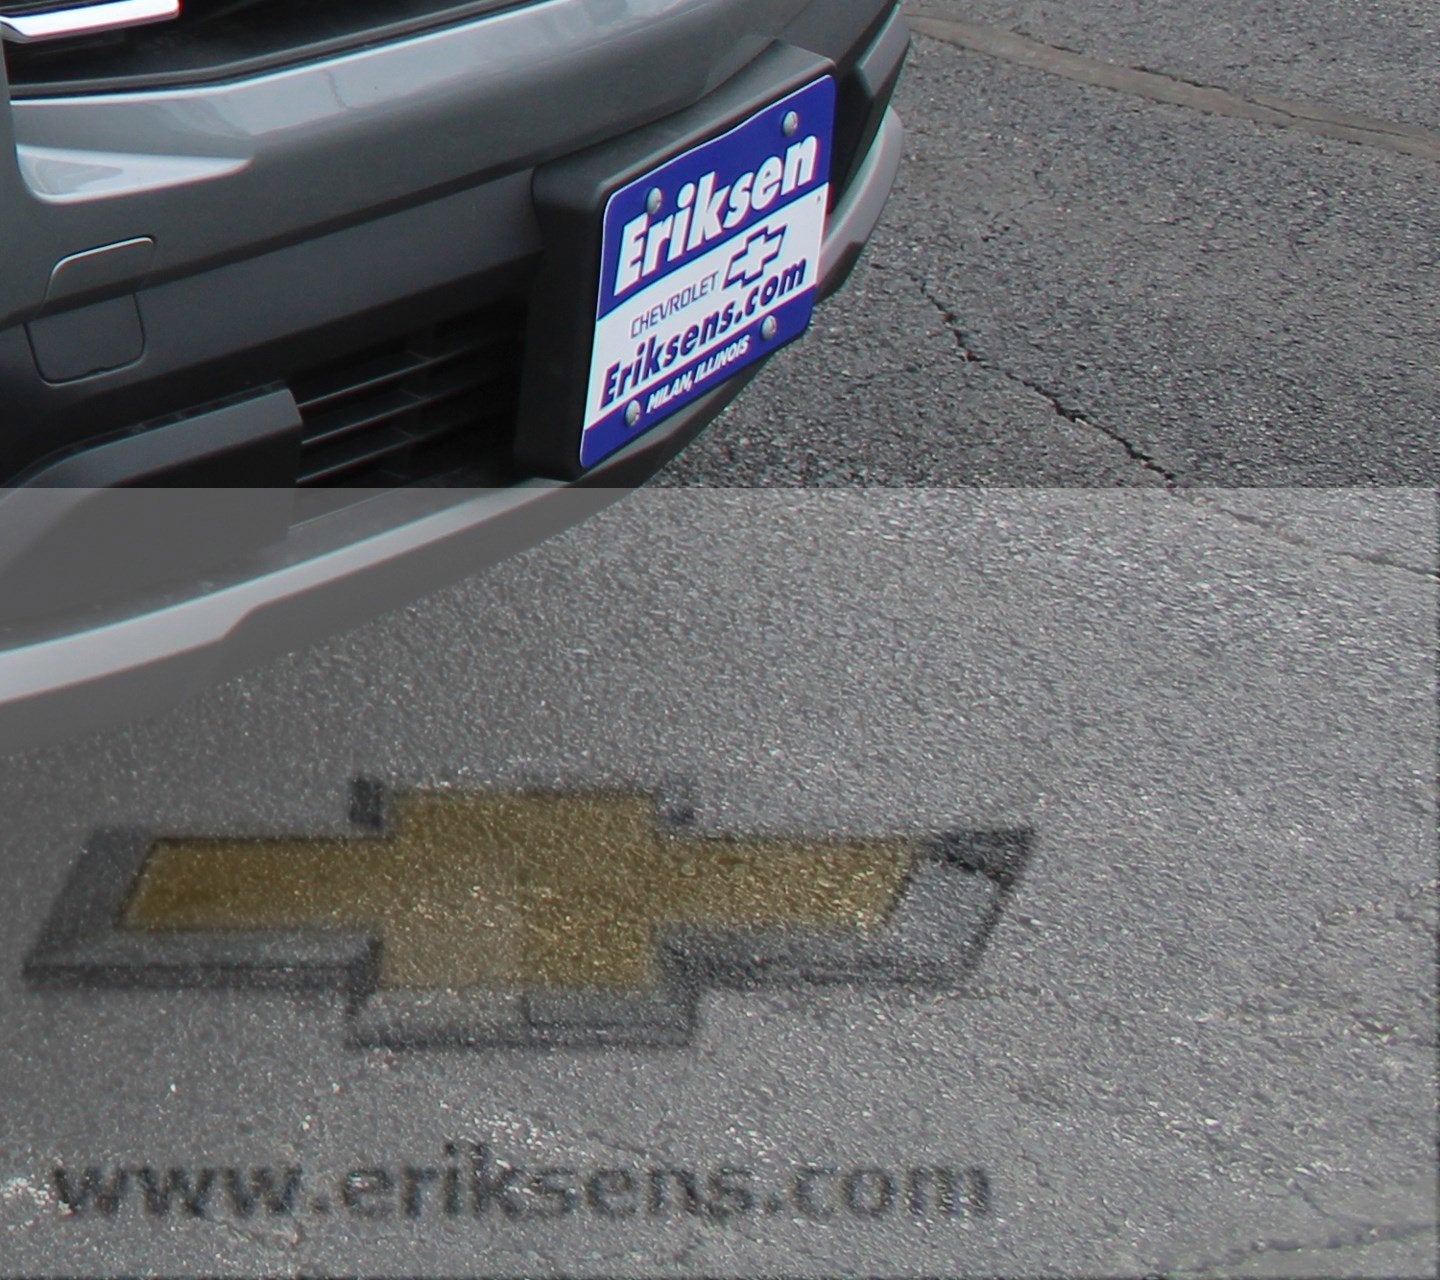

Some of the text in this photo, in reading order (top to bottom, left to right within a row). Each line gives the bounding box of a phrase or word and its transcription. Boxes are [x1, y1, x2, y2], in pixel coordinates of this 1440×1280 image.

[614, 134, 818, 297] Eriksen
[598, 256, 807, 410] Eriksens.com
[630, 270, 720, 340] CHEVROLET
[645, 333, 751, 414] MILAN, ILLINOIS
